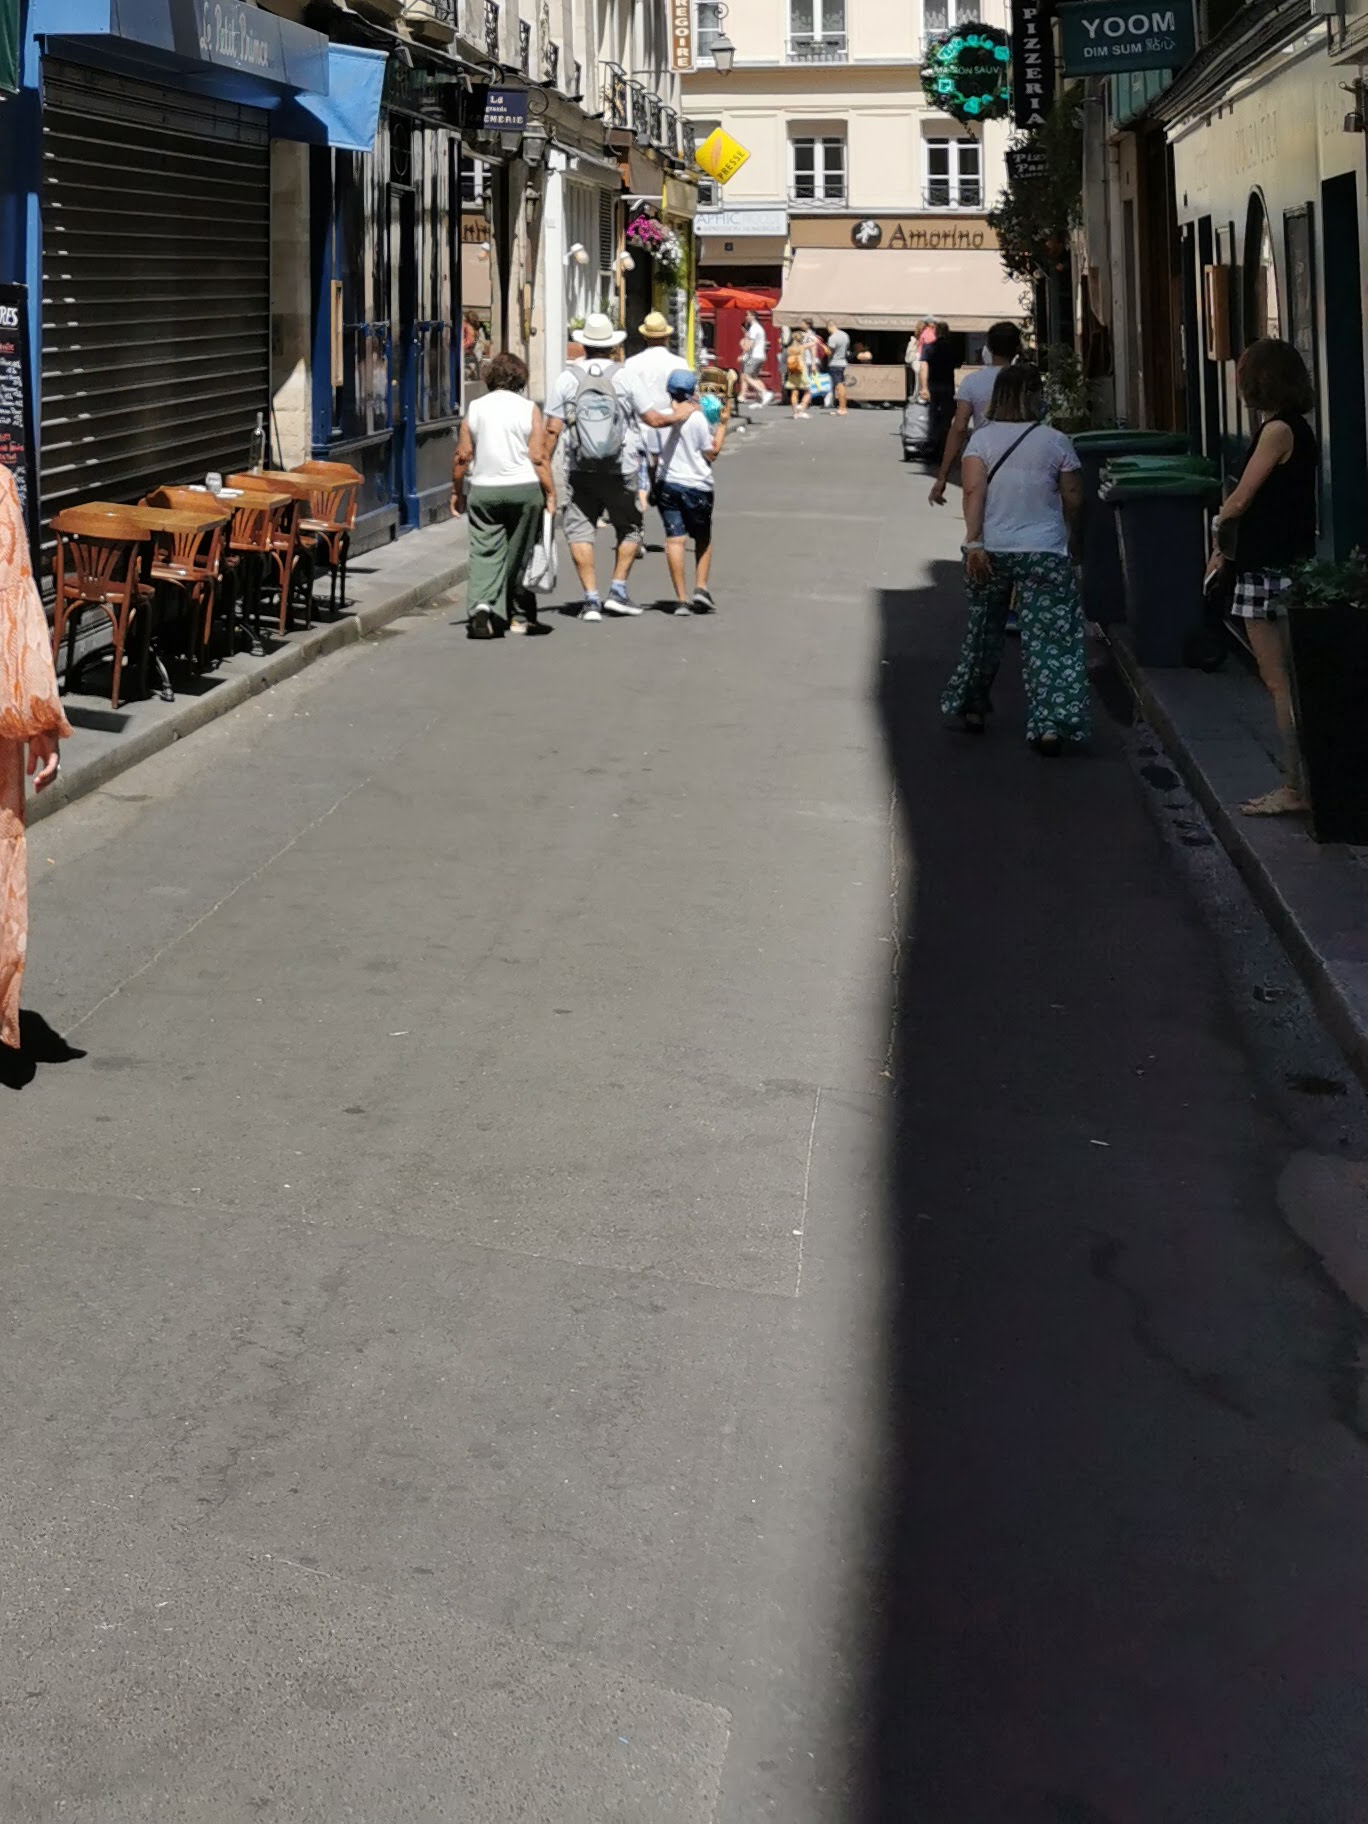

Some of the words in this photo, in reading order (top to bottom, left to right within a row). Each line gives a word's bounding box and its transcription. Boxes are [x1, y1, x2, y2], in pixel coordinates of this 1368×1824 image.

[1081, 11, 1175, 39] YOOM
[1083, 46, 1108, 58] DIM
[1112, 43, 1142, 55] SUM
[1023, 8, 1047, 125] PIZZERIA
[490, 95, 504, 104] La
[717, 150, 746, 181] PRESSE
[888, 224, 985, 249] Amorino
